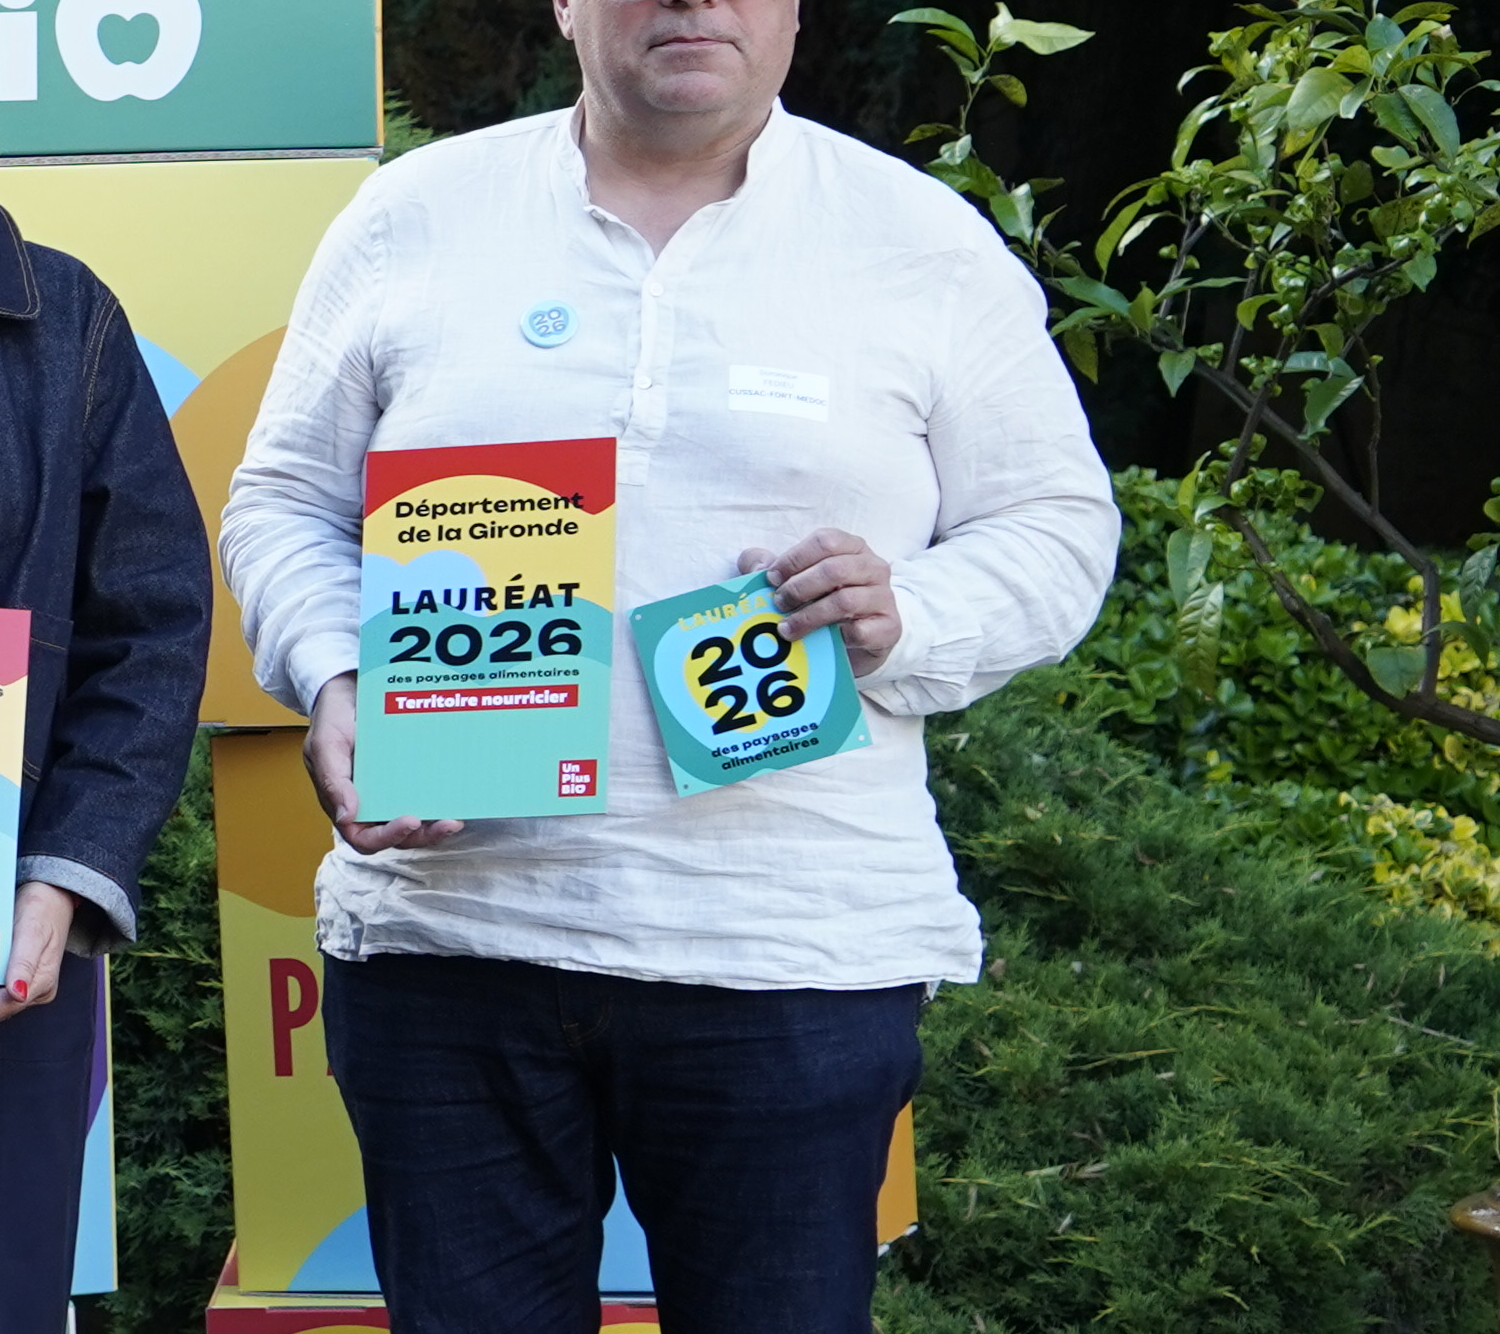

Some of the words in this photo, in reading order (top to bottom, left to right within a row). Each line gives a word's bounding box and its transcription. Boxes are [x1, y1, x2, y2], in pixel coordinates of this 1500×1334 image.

[533, 309, 561, 326] 20
[537, 320, 566, 337] 26
[395, 492, 585, 520] Département
[397, 526, 431, 543] de
[438, 525, 462, 542] la
[468, 519, 579, 540] Gironde
[392, 574, 581, 615] LAURÉAT
[389, 618, 582, 666] 2026
[690, 621, 792, 687] 20
[387, 672, 412, 684] des
[415, 672, 486, 685] paysages
[489, 667, 580, 680] alimentaires
[395, 694, 478, 711] Territoire
[481, 690, 568, 707] nourricier
[704, 670, 806, 736] 26
[712, 743, 740, 758] des
[742, 721, 819, 750] paysages
[722, 735, 820, 771] alimentaires
[562, 763, 580, 773] Un
[562, 774, 590, 783] Plus
